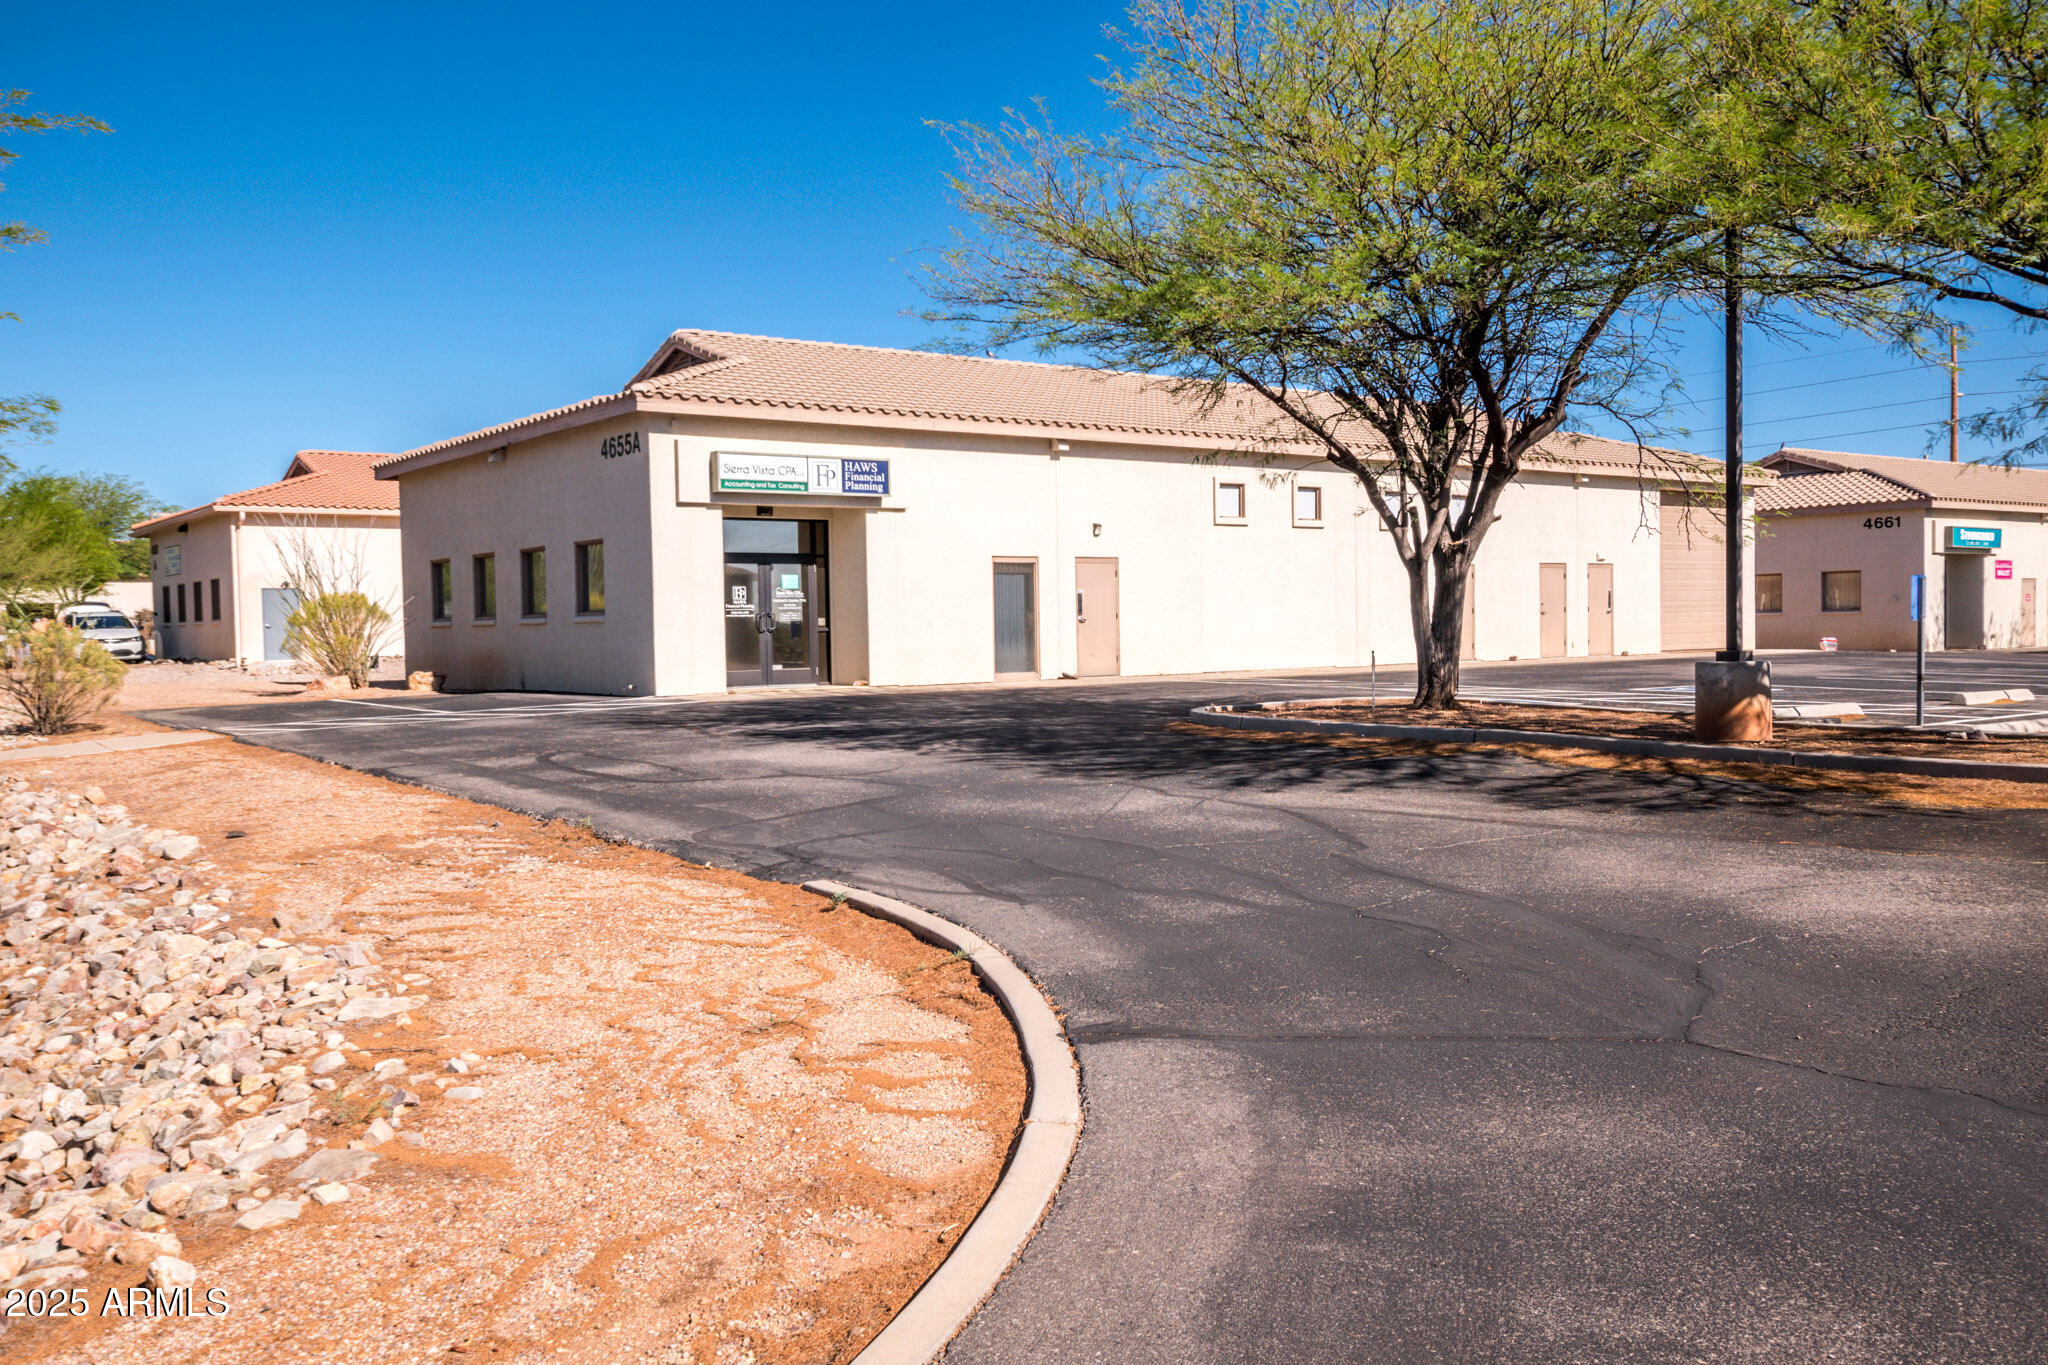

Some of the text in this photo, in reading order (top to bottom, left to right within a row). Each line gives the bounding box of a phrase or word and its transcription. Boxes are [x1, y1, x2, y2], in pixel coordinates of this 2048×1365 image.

[601, 431, 641, 460] 4655A
[723, 463, 750, 475] Sierra
[752, 464, 776, 476] Vista
[843, 461, 878, 473] HAWS
[844, 471, 886, 482] Financial
[724, 480, 756, 489] Accounting
[778, 483, 805, 491] Consulting
[844, 481, 884, 493] Planning
[1864, 516, 1901, 530] 4661
